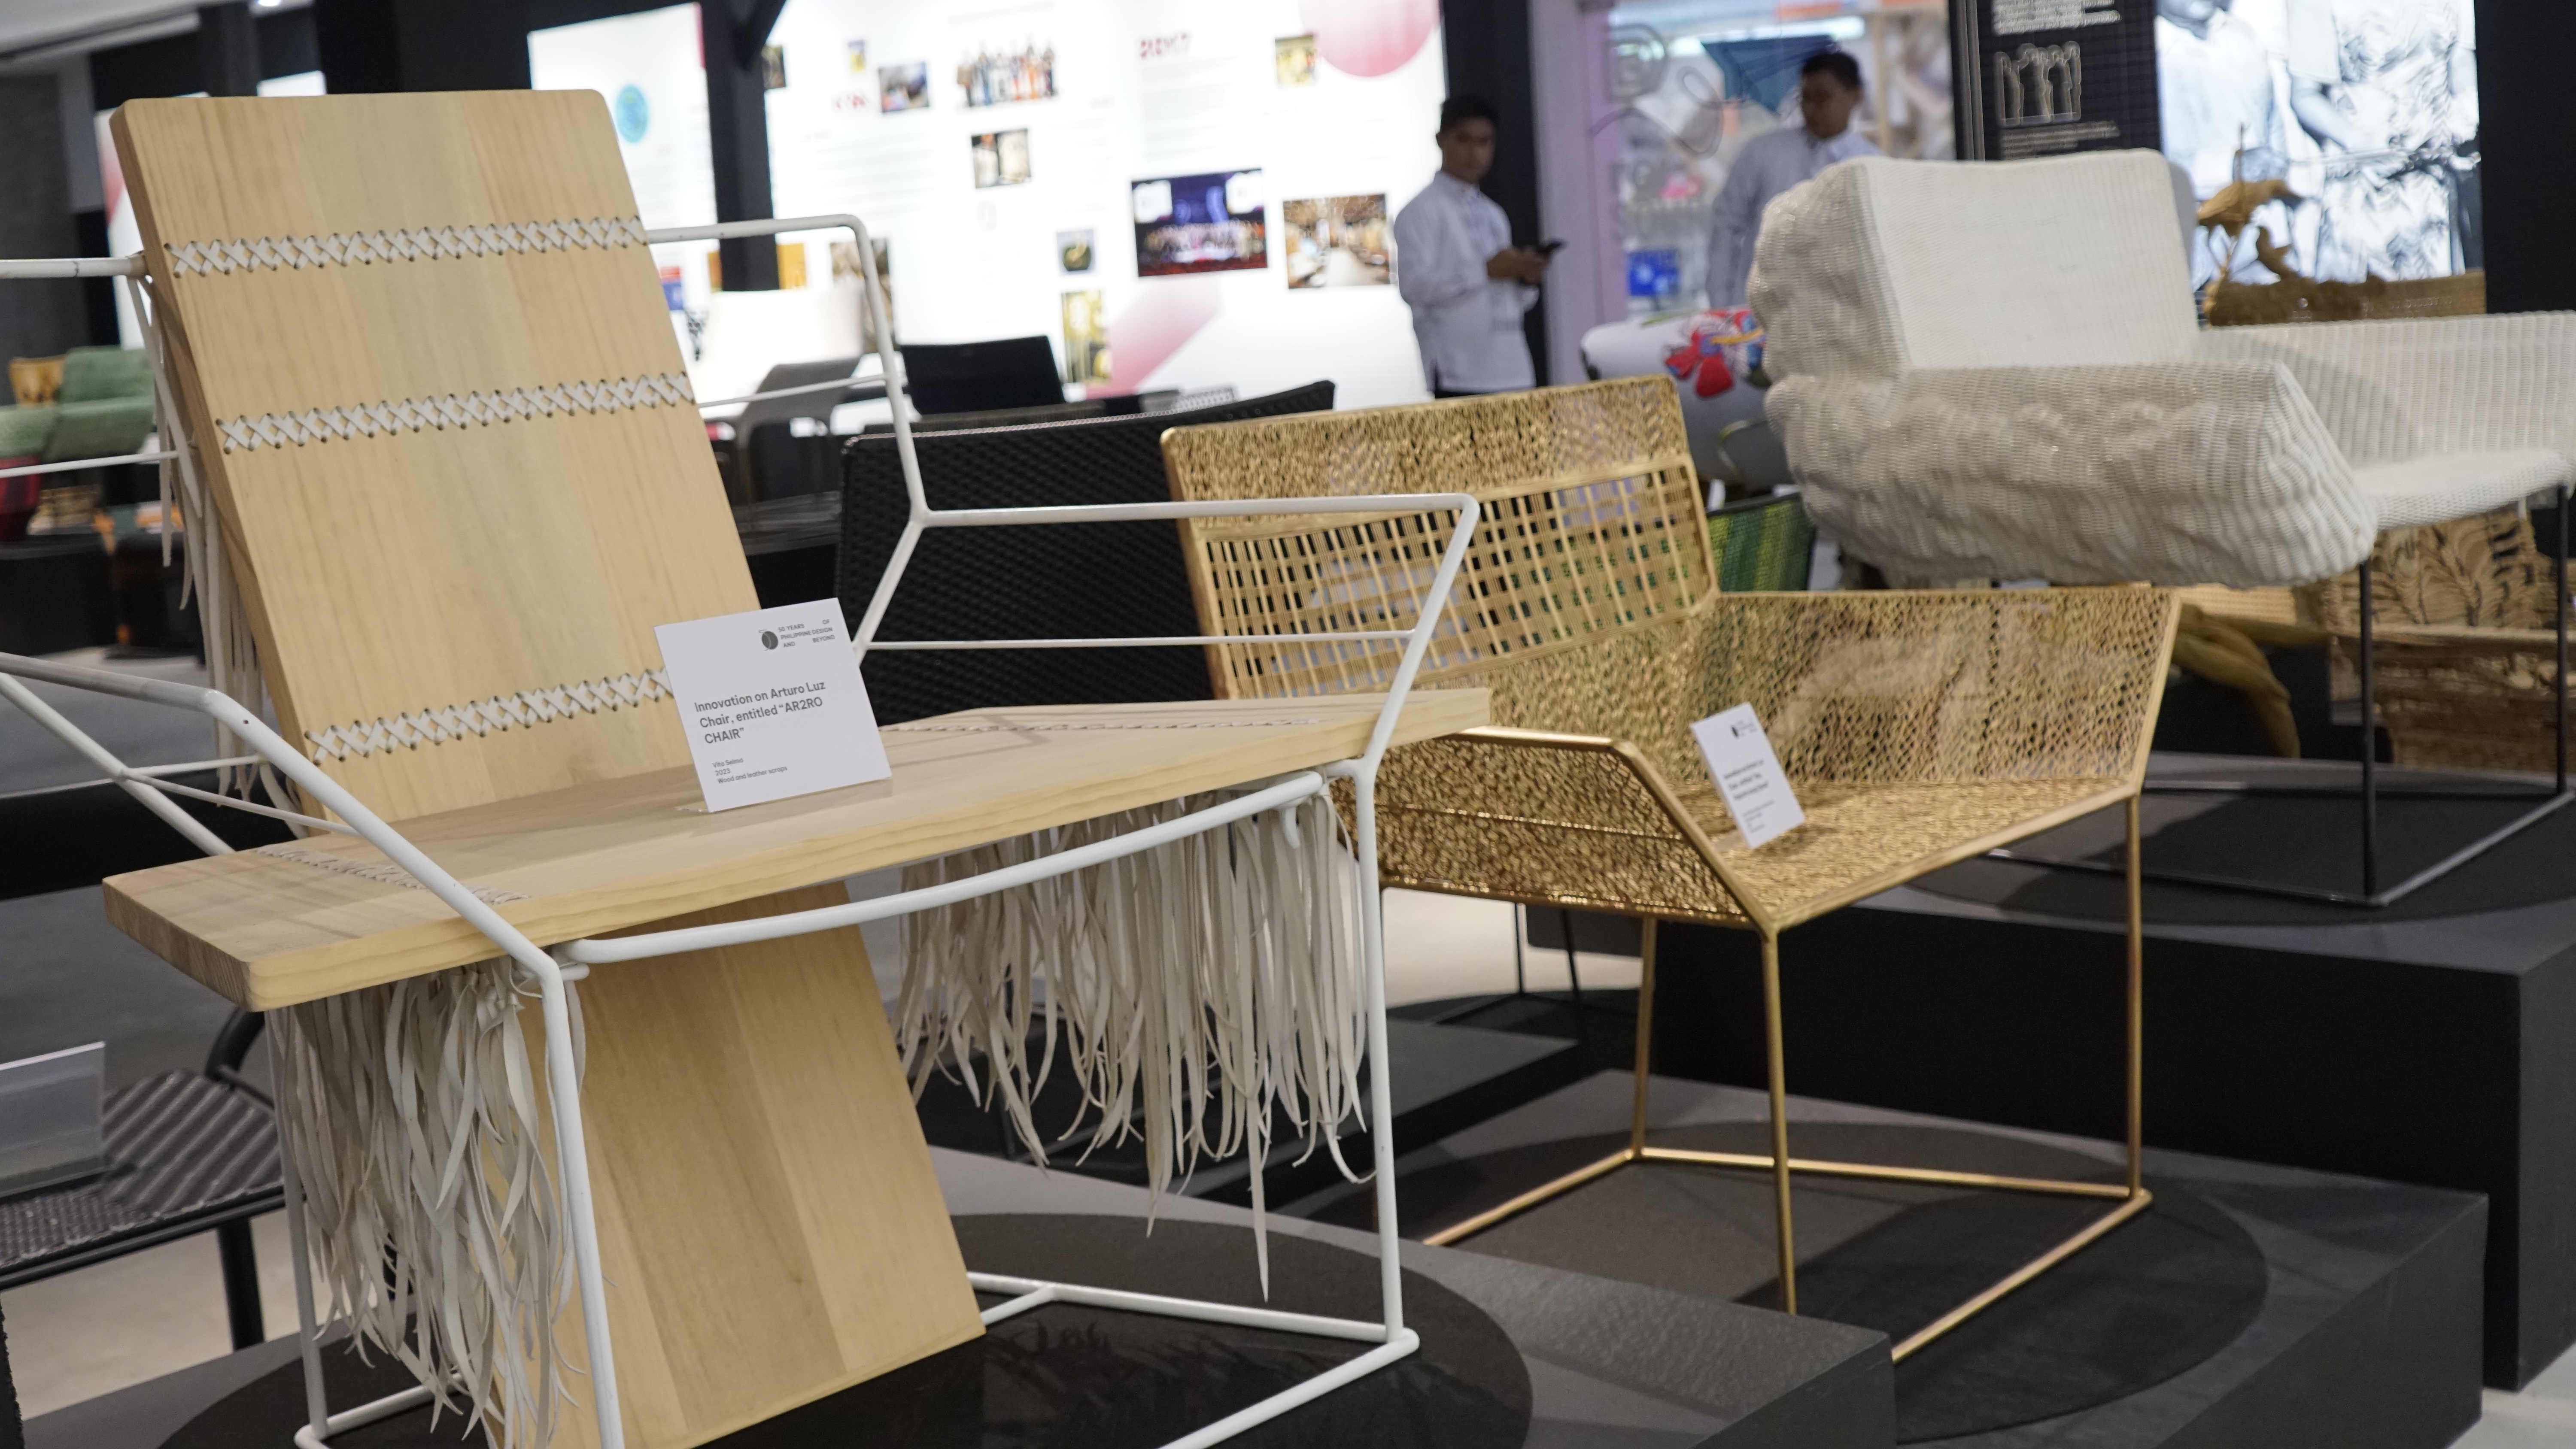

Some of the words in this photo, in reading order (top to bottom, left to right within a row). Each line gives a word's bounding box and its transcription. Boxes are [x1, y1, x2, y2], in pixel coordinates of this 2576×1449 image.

[780, 631, 811, 639] PHILIPPINE
[812, 635, 835, 643] BEYOND
[694, 694, 753, 712] Innovation
[754, 692, 769, 701] on
[771, 685, 805, 699] Arturo
[806, 682, 826, 692] Luz
[699, 713, 734, 728] Chair,
[736, 705, 778, 722] entitled
[715, 768, 731, 776] 2023
[717, 776, 735, 784] Wood
[747, 770, 767, 778] leather
